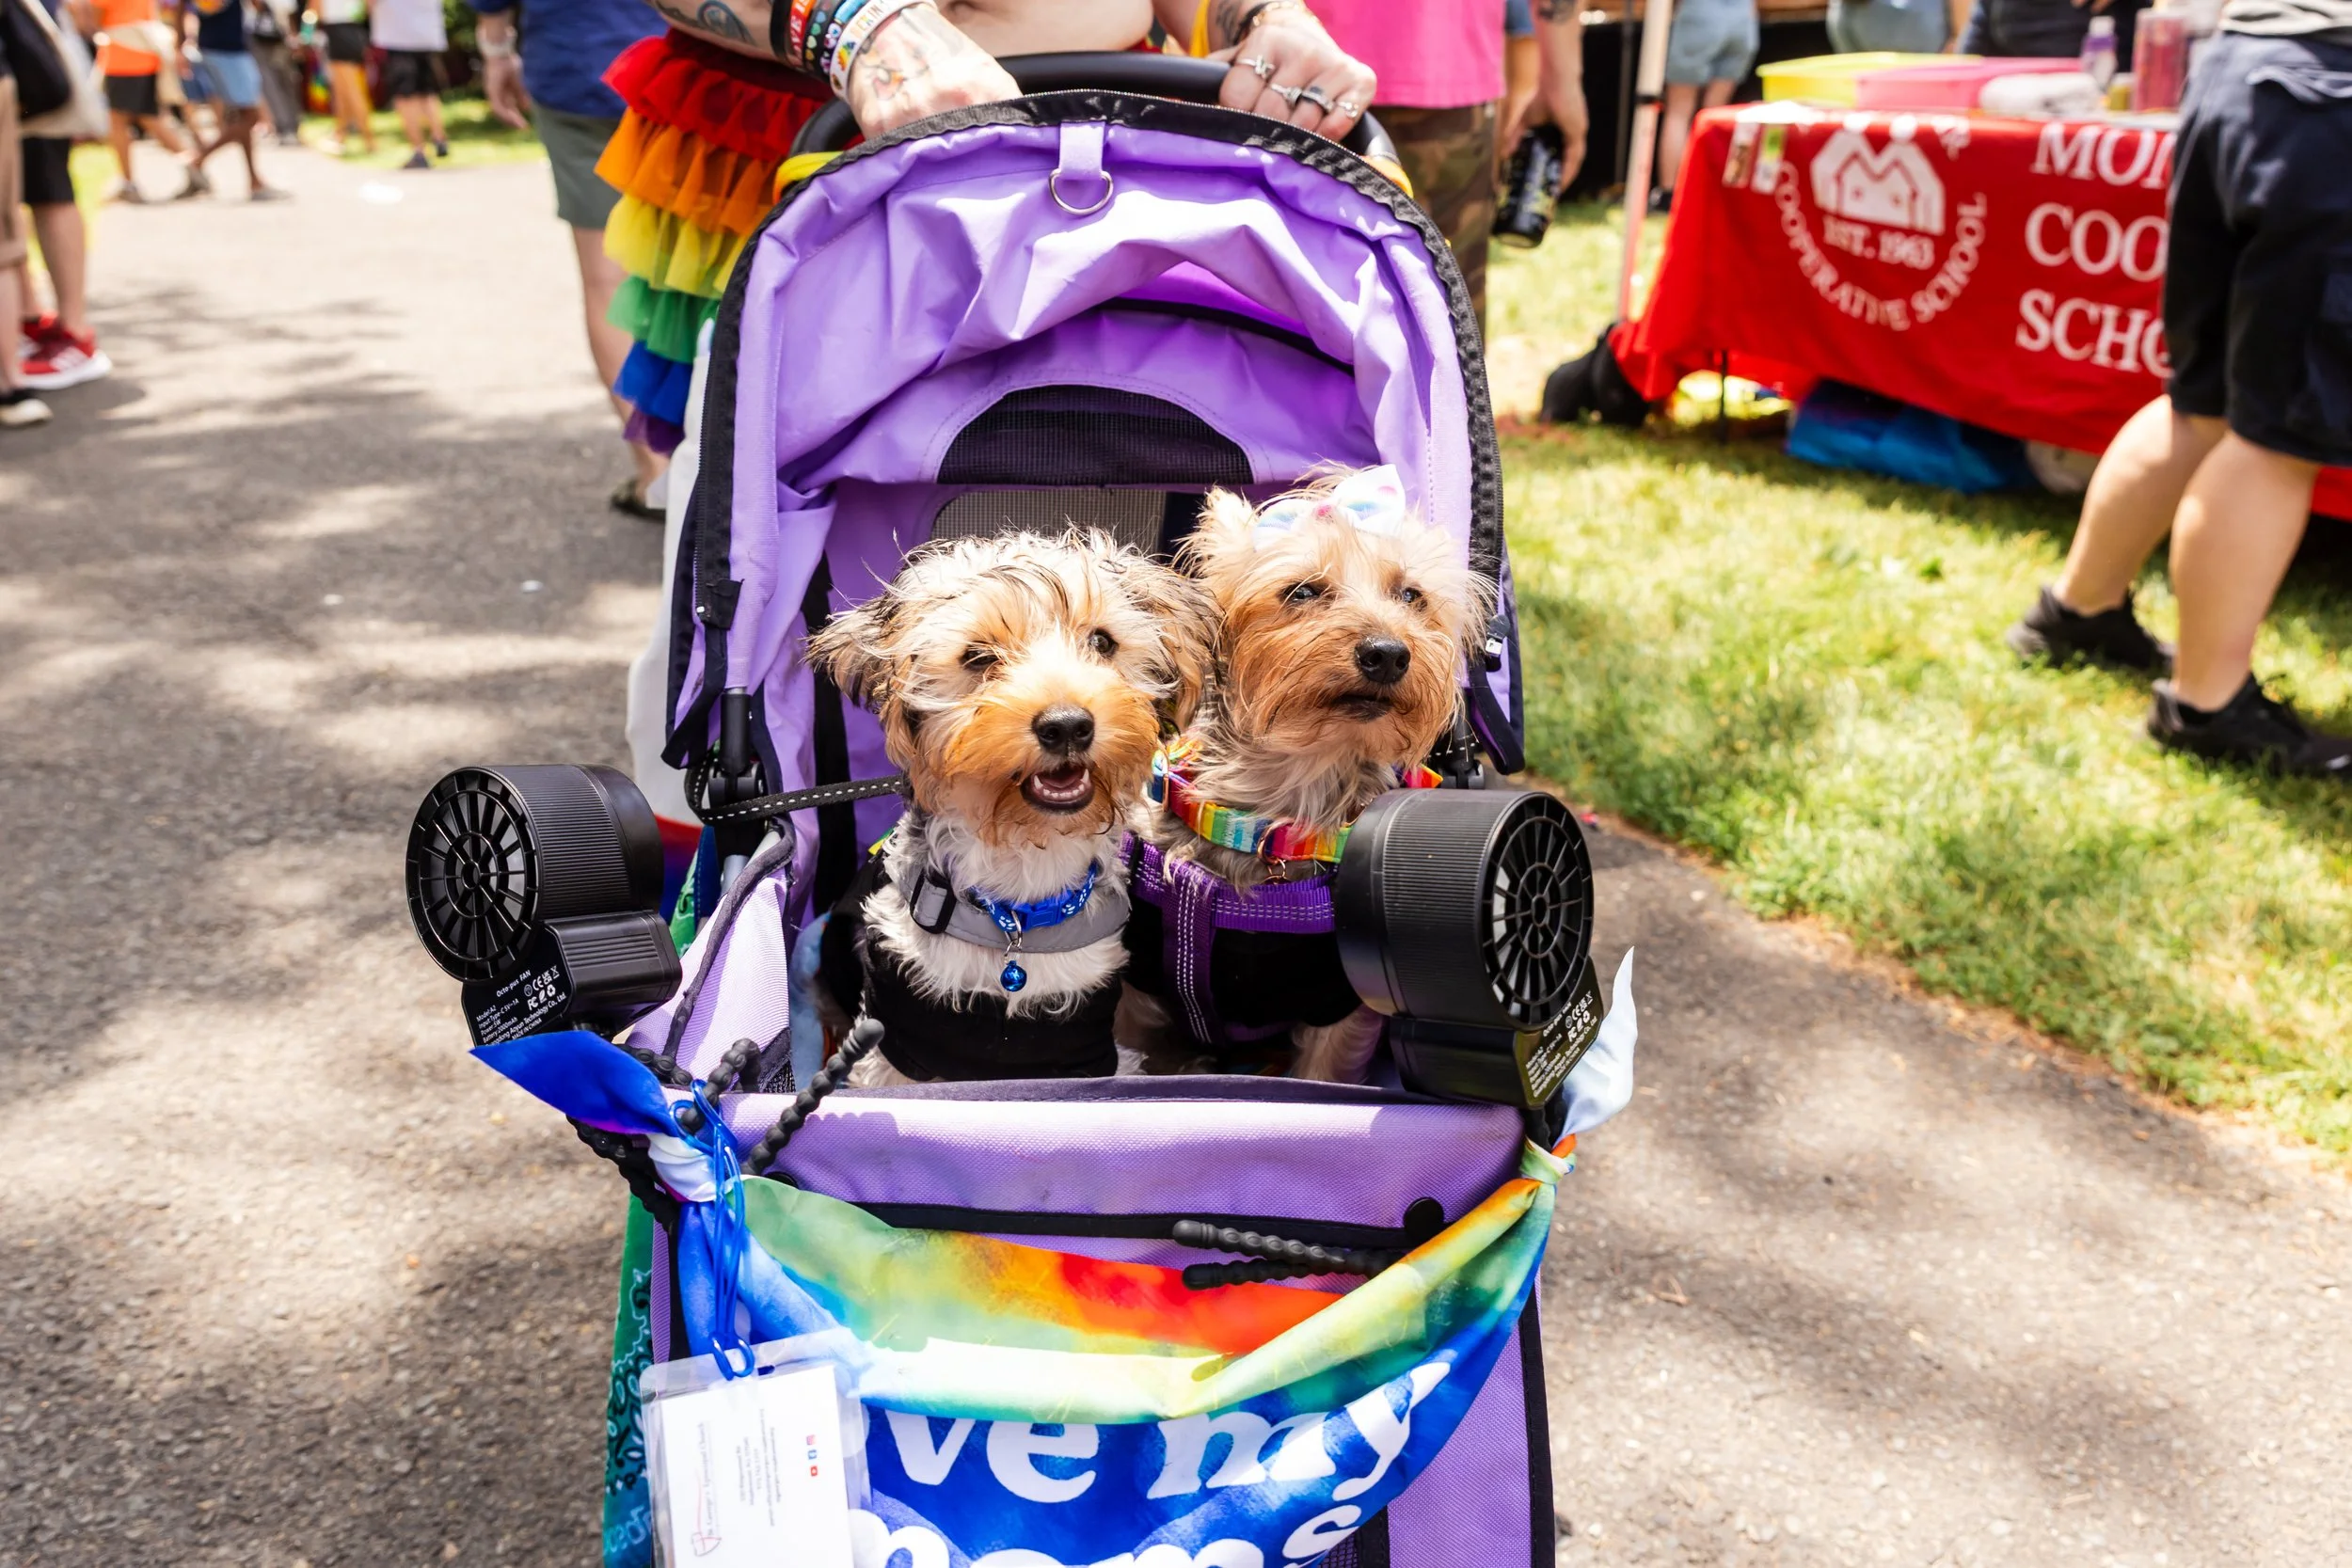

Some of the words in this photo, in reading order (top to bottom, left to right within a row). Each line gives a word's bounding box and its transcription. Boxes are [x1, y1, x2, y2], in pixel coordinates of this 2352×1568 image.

[1821, 213, 1877, 259] EST.
[1911, 191, 1987, 324] SCHOOL
[497, 979, 519, 997] Octo-pus
[519, 970, 531, 981] FAN
[532, 976, 544, 990] CE
[524, 1006, 548, 1023] Technology
[529, 1018, 542, 1029] CHINA
[1147, 1362, 1452, 1502] my
